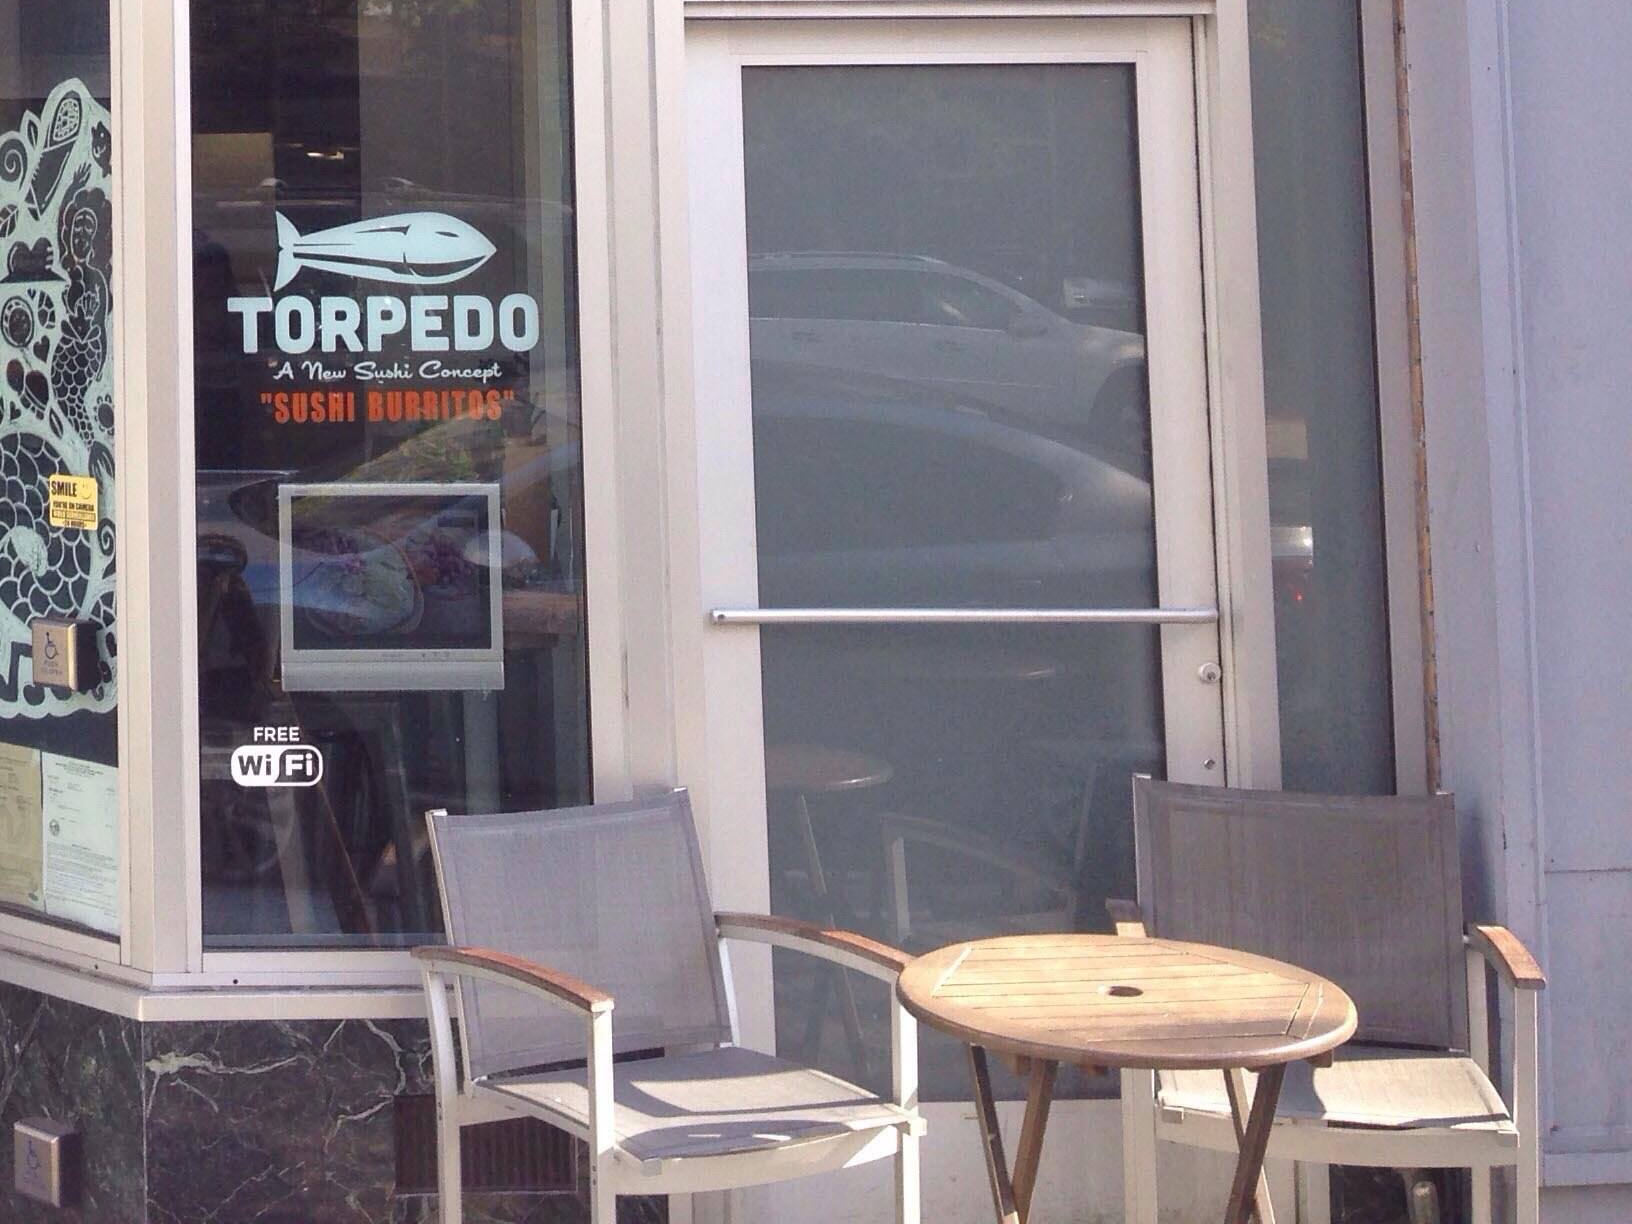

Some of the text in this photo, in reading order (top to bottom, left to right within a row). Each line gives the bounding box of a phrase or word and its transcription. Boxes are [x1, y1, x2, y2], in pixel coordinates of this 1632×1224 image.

[227, 293, 539, 354] TORPEDO
[301, 360, 347, 380] New
[354, 360, 414, 382] Sushi
[418, 359, 503, 384] Concept
[260, 389, 355, 424] "SUSHI
[51, 480, 77, 497] SMILE
[253, 726, 300, 742] FREE
